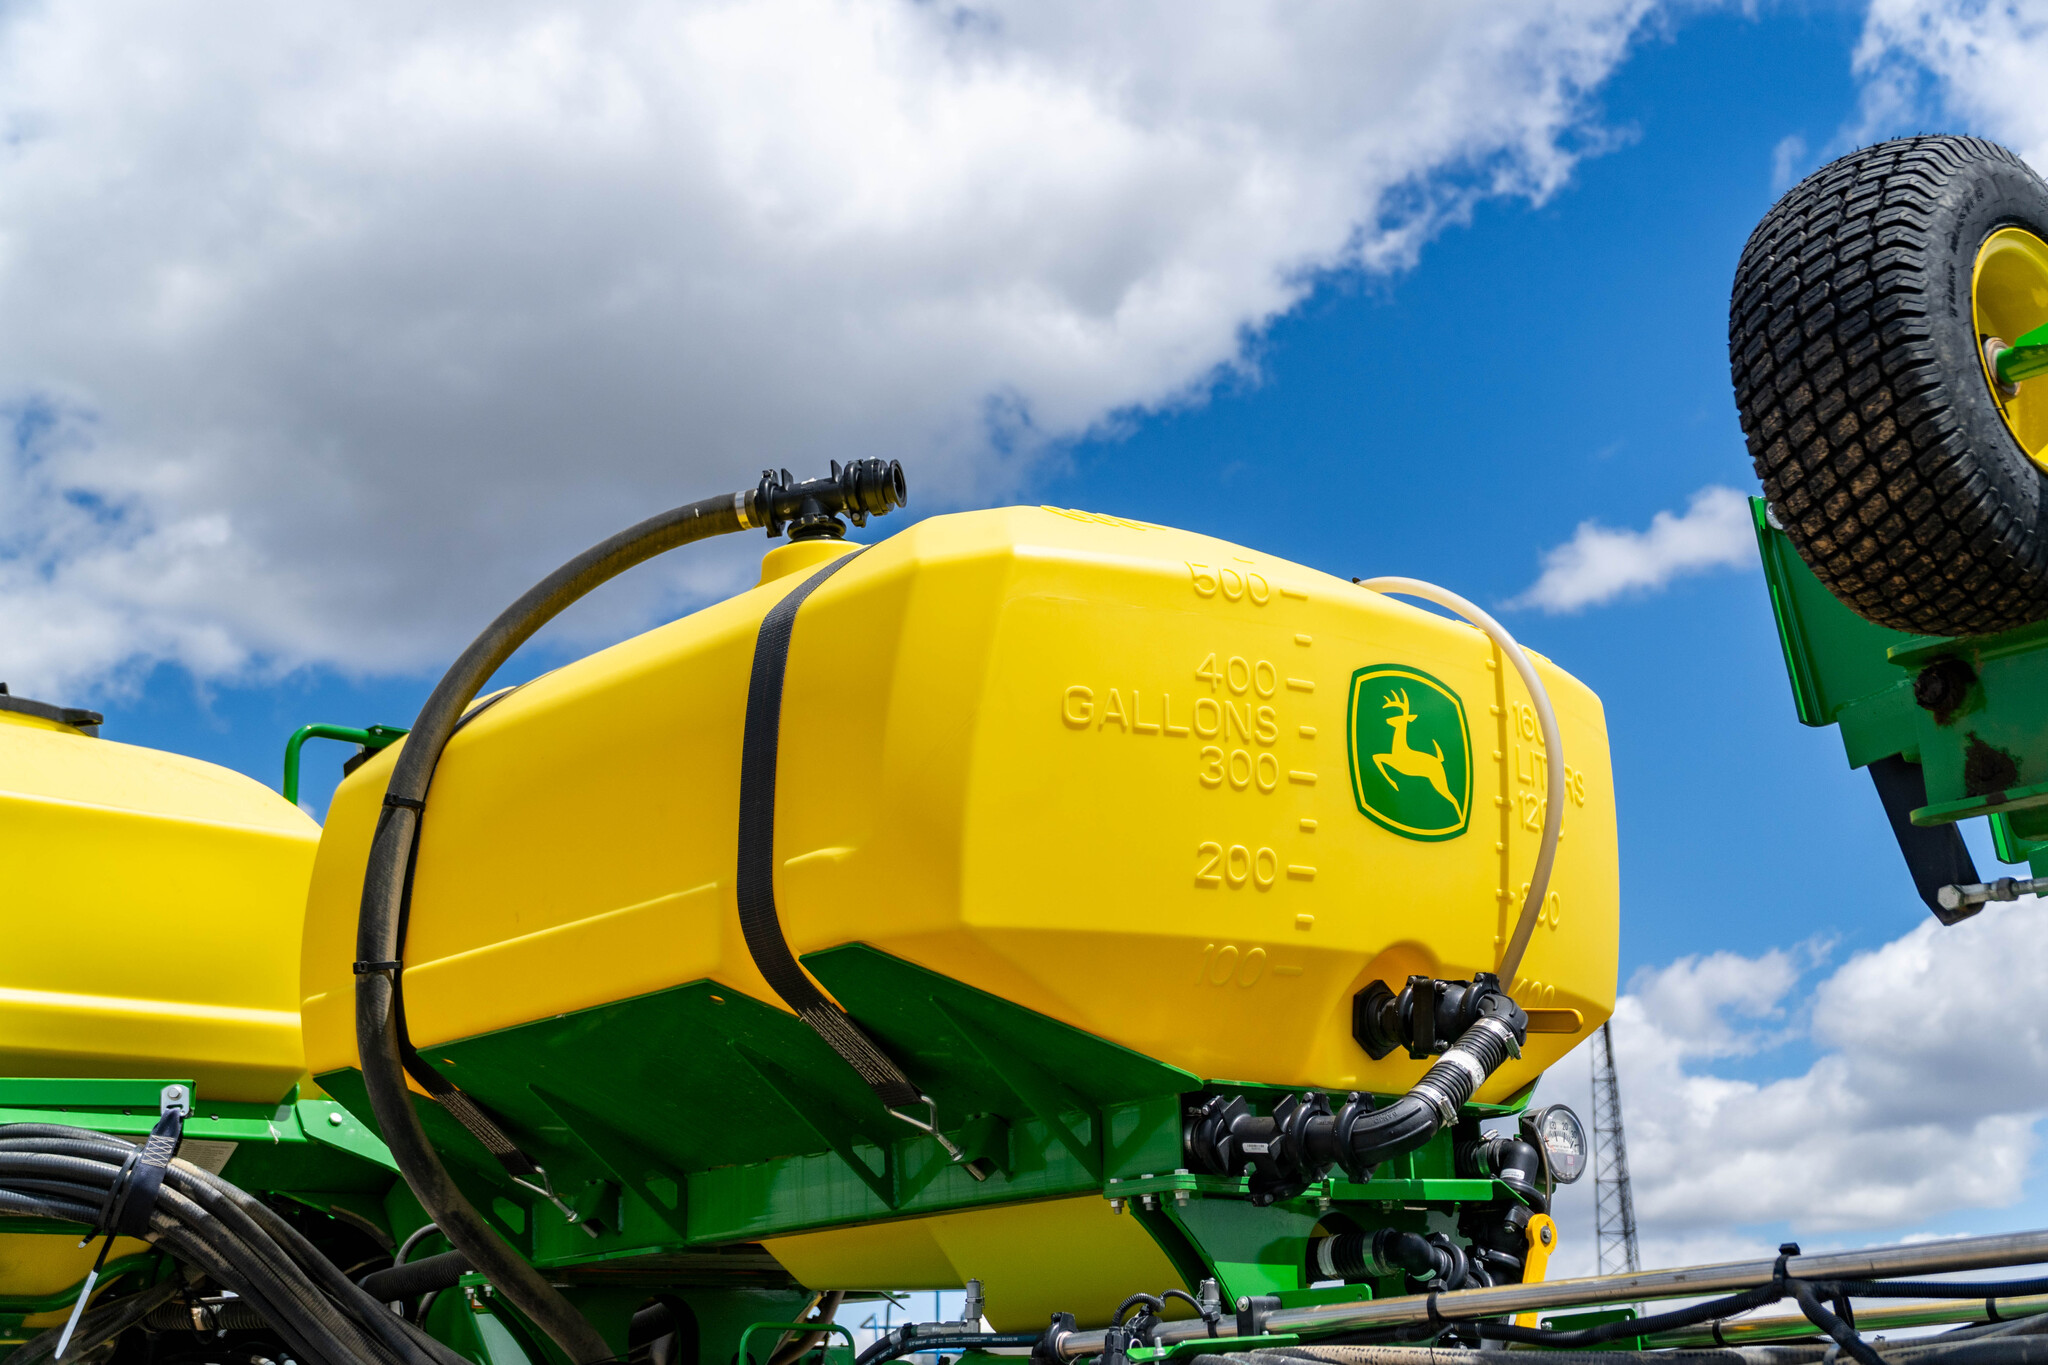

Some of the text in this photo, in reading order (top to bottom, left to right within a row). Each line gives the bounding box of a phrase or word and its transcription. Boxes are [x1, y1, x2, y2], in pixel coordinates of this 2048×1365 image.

[1183, 560, 1270, 604] 500
[1195, 653, 1277, 698] 400
[1062, 685, 1278, 744] GALLONS
[1200, 746, 1279, 793] 300
[1516, 744, 1585, 808] LITRS
[1195, 841, 1277, 890] 200
[1195, 943, 1267, 987] 100
